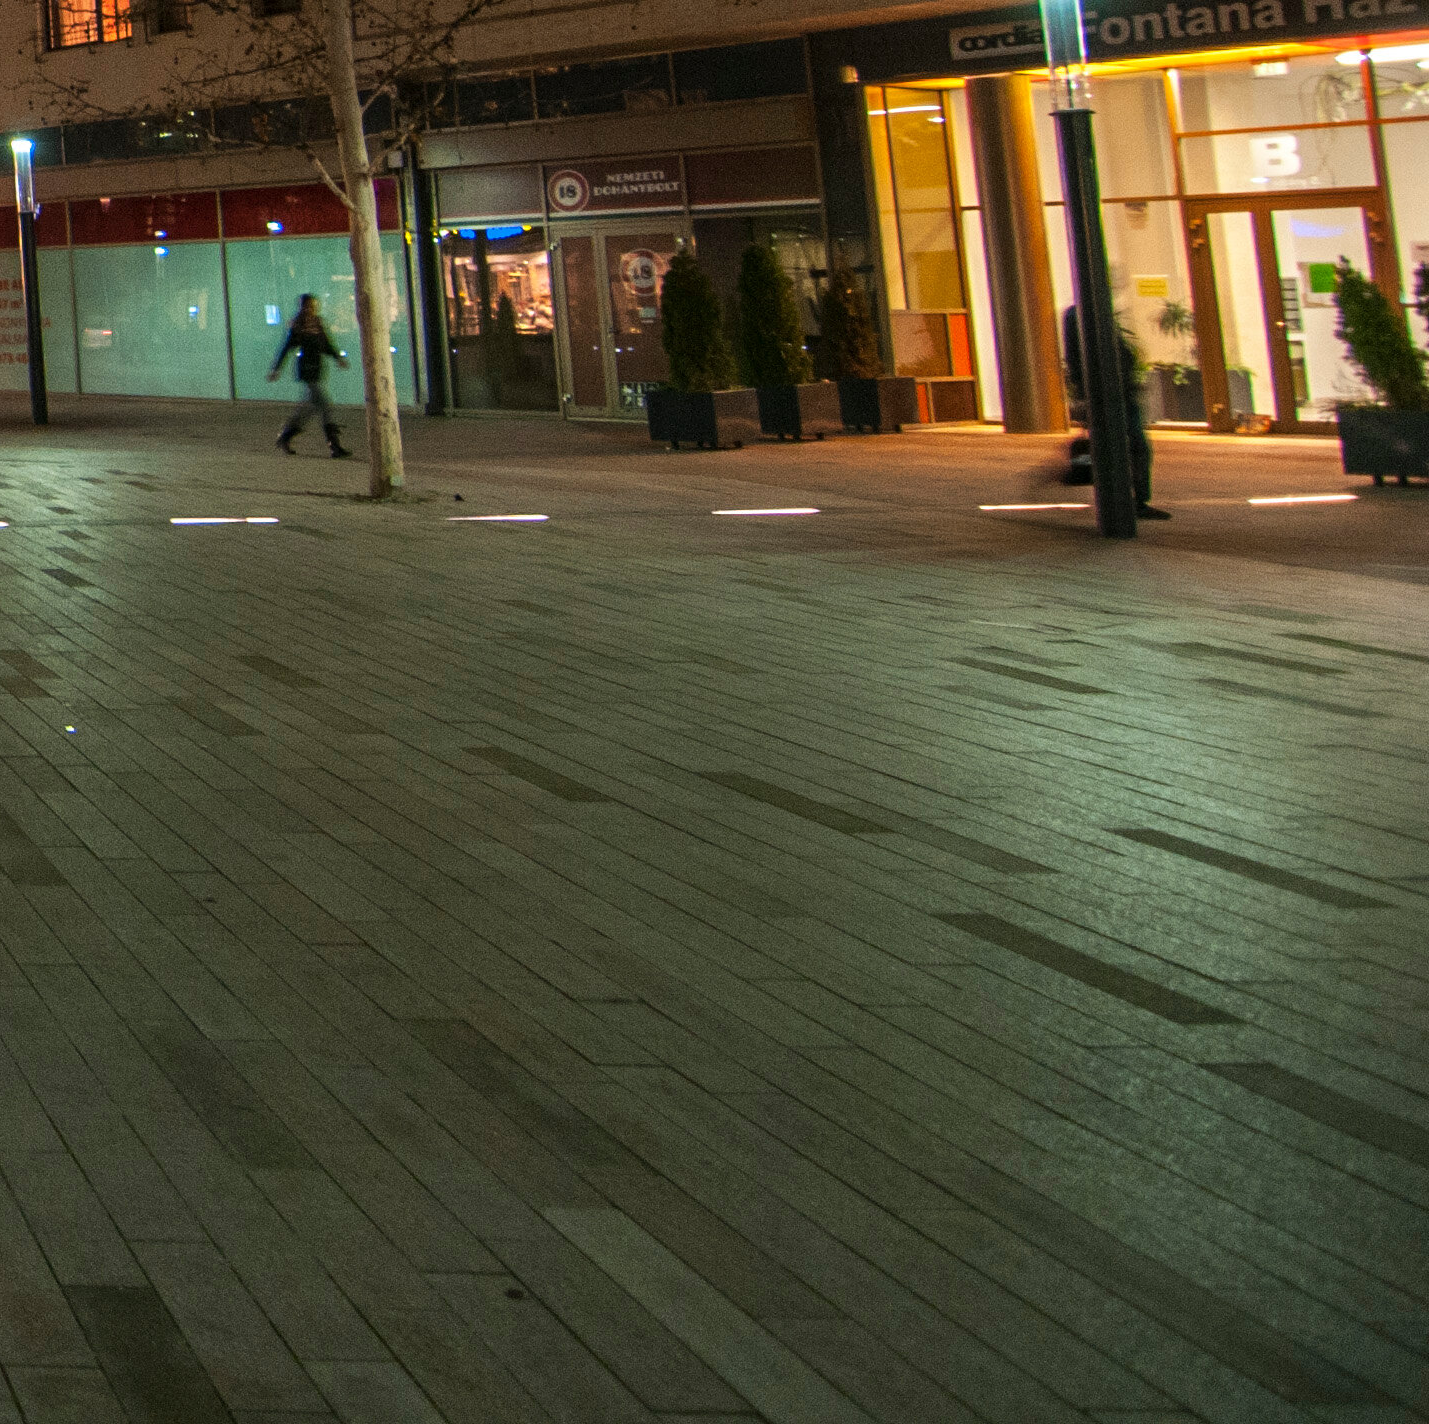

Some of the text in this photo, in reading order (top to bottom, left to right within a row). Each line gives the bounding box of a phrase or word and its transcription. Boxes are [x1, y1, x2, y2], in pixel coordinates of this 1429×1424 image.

[1249, 133, 1302, 178] B
[606, 169, 666, 183] NEMZETI
[558, 184, 578, 200] 18
